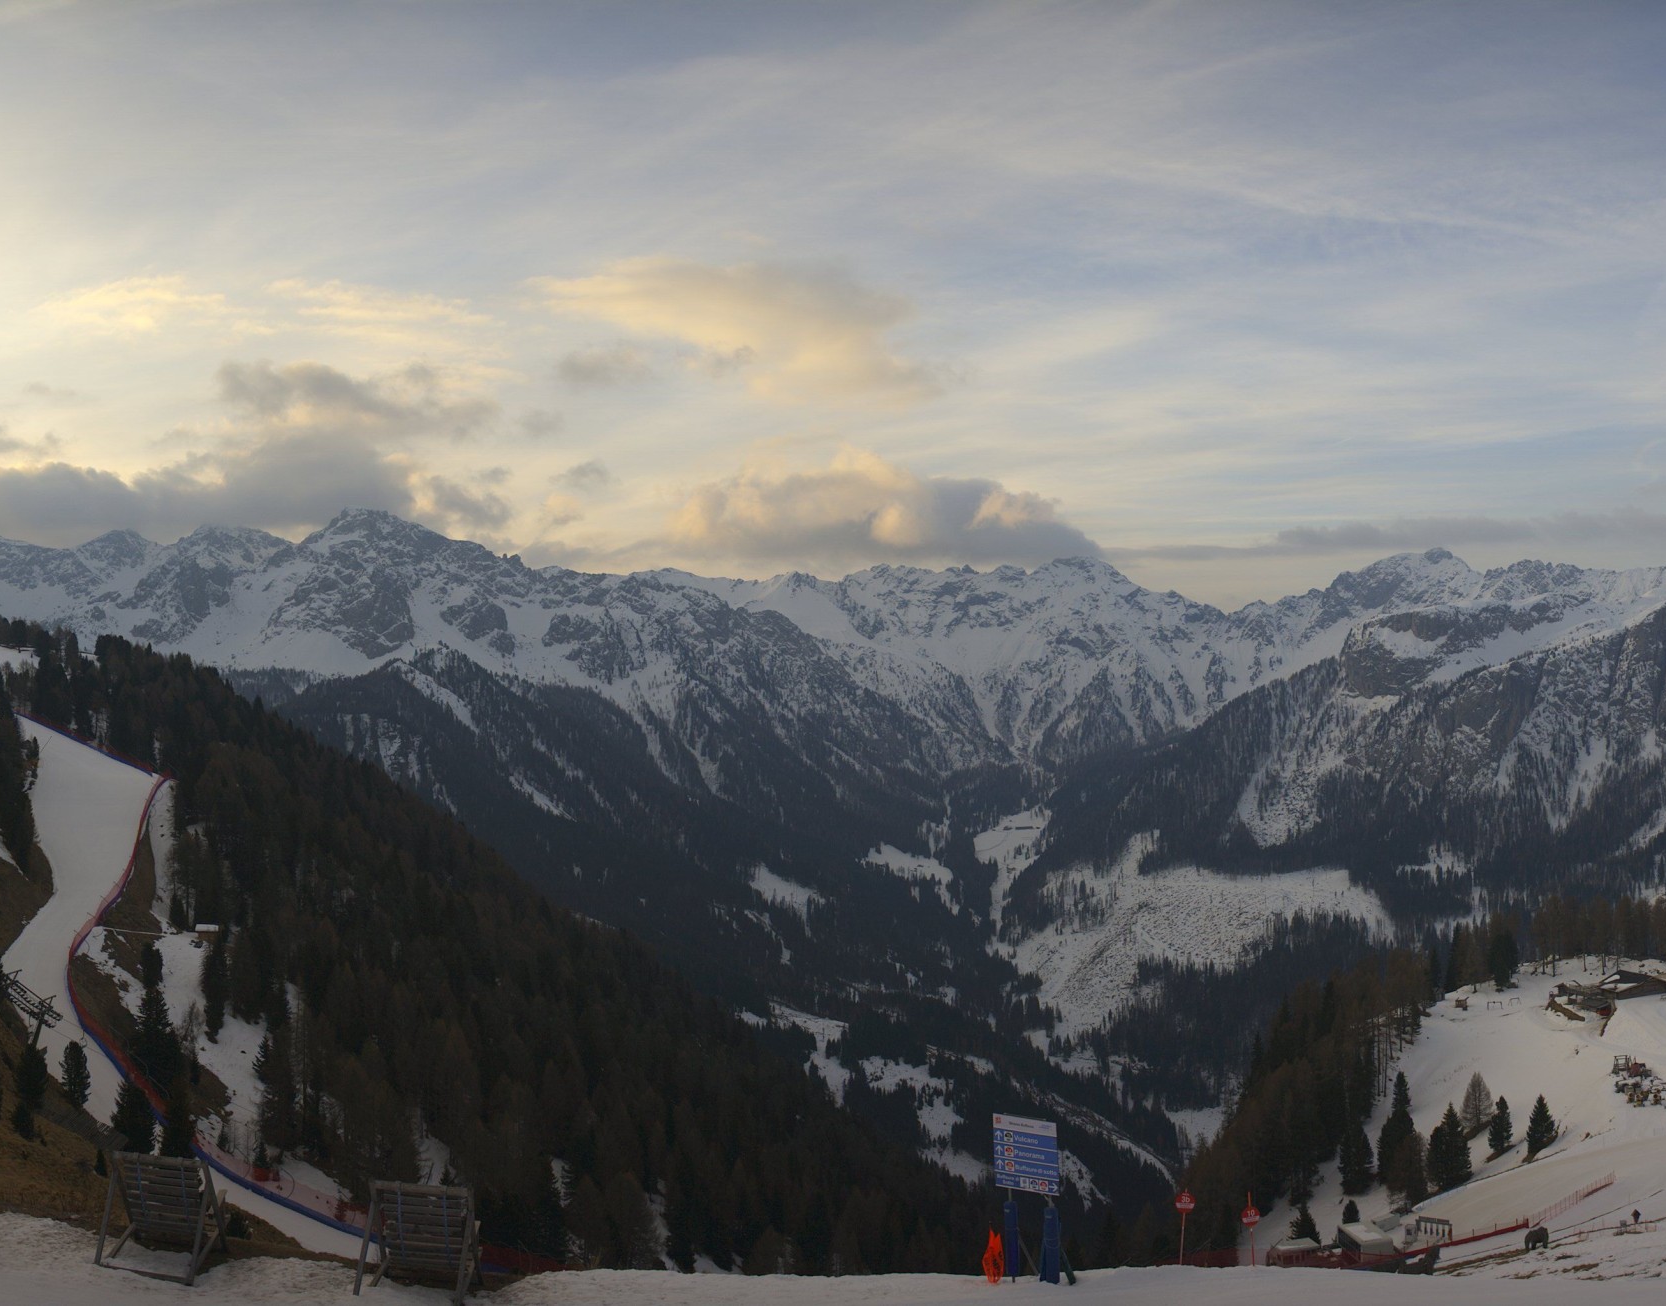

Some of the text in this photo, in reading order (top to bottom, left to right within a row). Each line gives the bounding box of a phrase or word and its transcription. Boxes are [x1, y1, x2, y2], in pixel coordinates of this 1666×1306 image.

[1014, 1135, 1038, 1144] Vulcano
[1015, 1150, 1045, 1160] Panorama
[1246, 1209, 1255, 1217] 10
